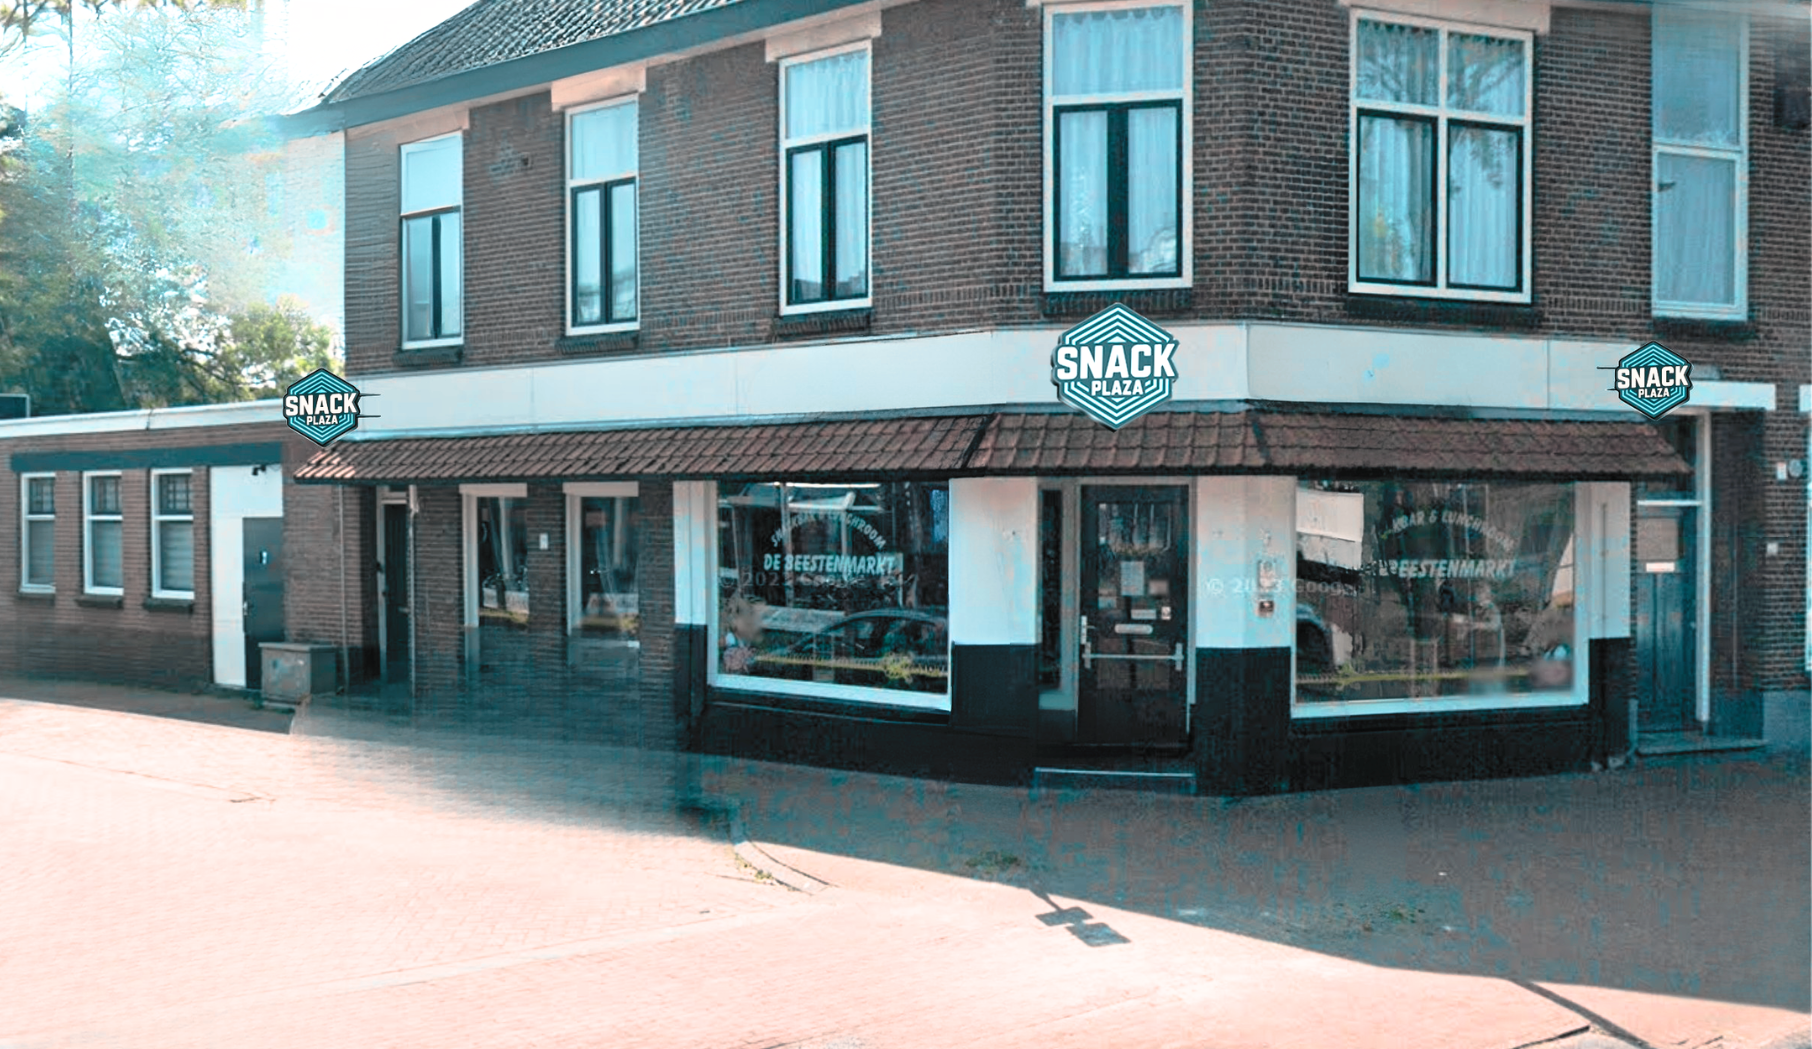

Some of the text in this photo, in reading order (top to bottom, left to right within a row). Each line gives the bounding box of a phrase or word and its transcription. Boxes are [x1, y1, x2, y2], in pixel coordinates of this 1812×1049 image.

[1057, 343, 1175, 380] SNACK
[1091, 380, 1143, 396] PLAZA
[1617, 365, 1689, 389] SNACK
[1638, 388, 1670, 398] PLAZA
[285, 393, 357, 416] SNACK
[306, 415, 338, 426] PLAZA
[763, 553, 896, 575] DE BEESTENMARKT
